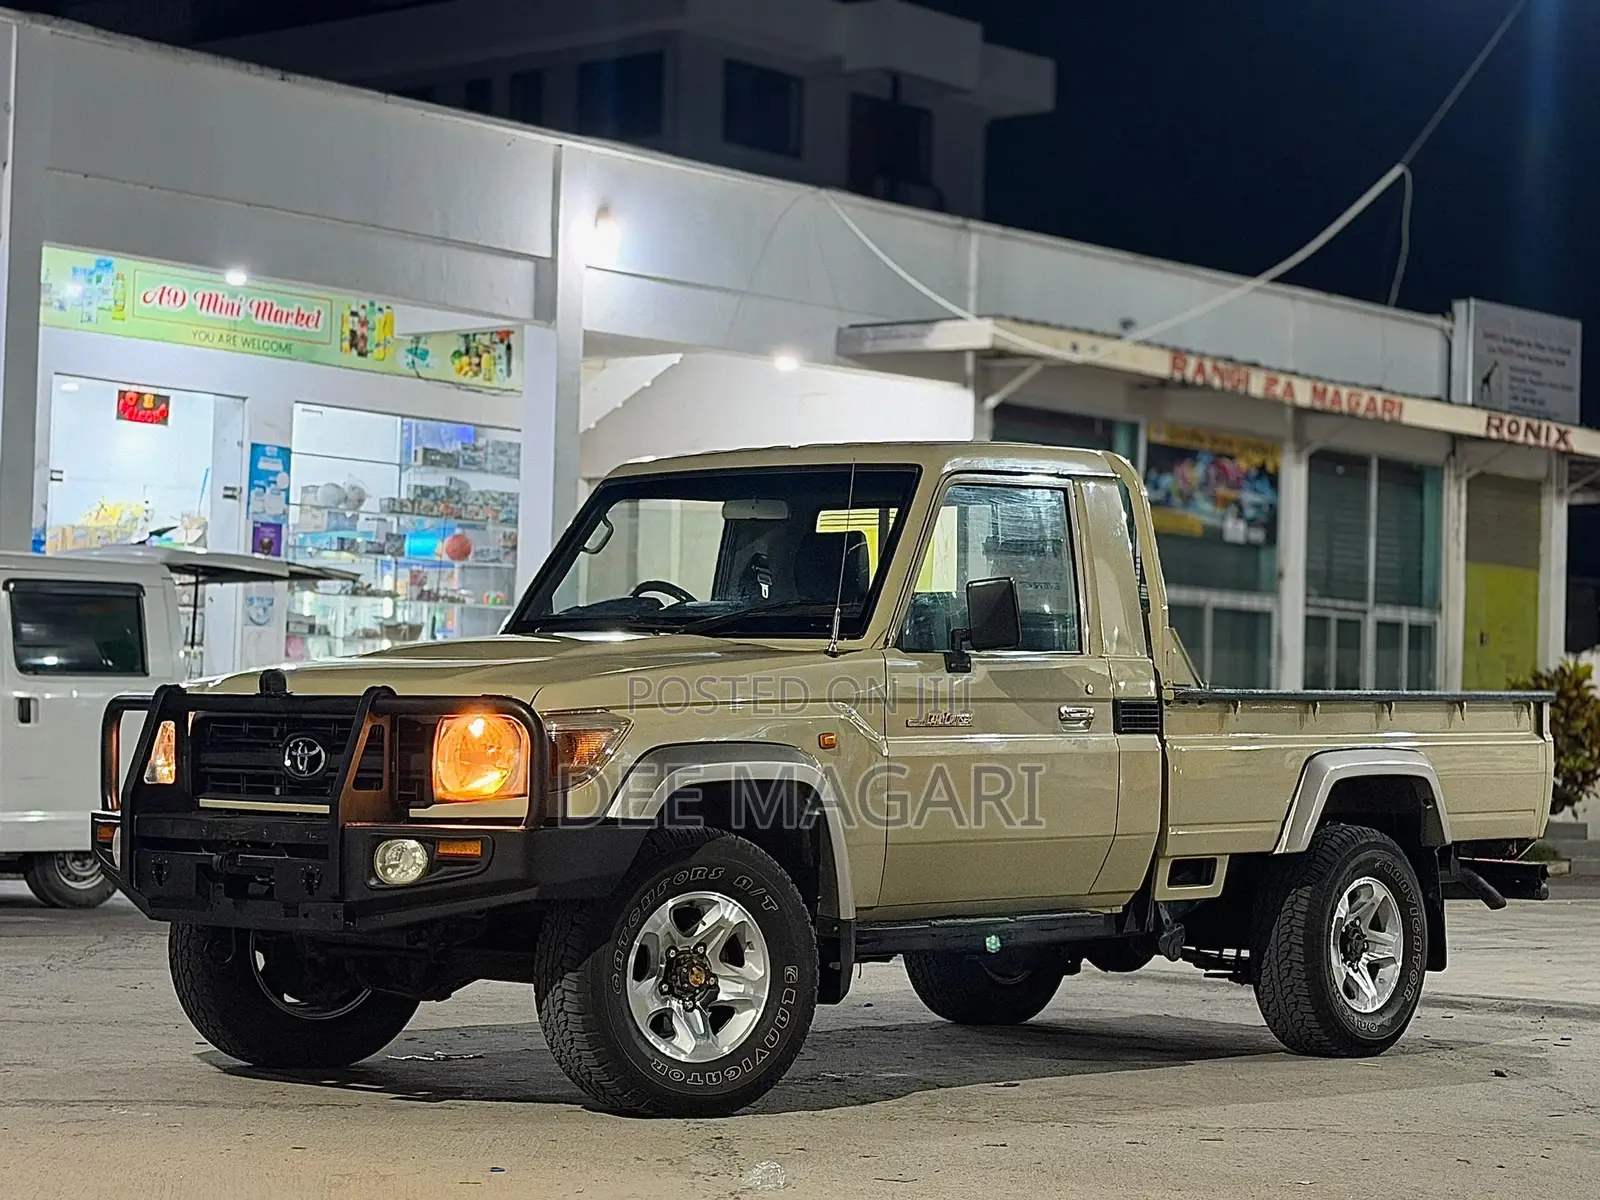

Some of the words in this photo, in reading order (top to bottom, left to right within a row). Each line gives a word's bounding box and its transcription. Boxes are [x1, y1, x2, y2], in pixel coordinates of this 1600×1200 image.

[142, 286, 187, 308] AD
[193, 290, 243, 318] Mini
[248, 299, 323, 330] Market
[192, 330, 215, 343] YOU
[218, 333, 237, 346] ARE
[240, 336, 294, 355] WELCOME
[1263, 374, 1295, 401] ZA
[1311, 382, 1404, 418] MAGARI
[1486, 414, 1574, 449] RONIX
[732, 875, 779, 913] A/T
[650, 987, 797, 1086] LANVIGATOR
